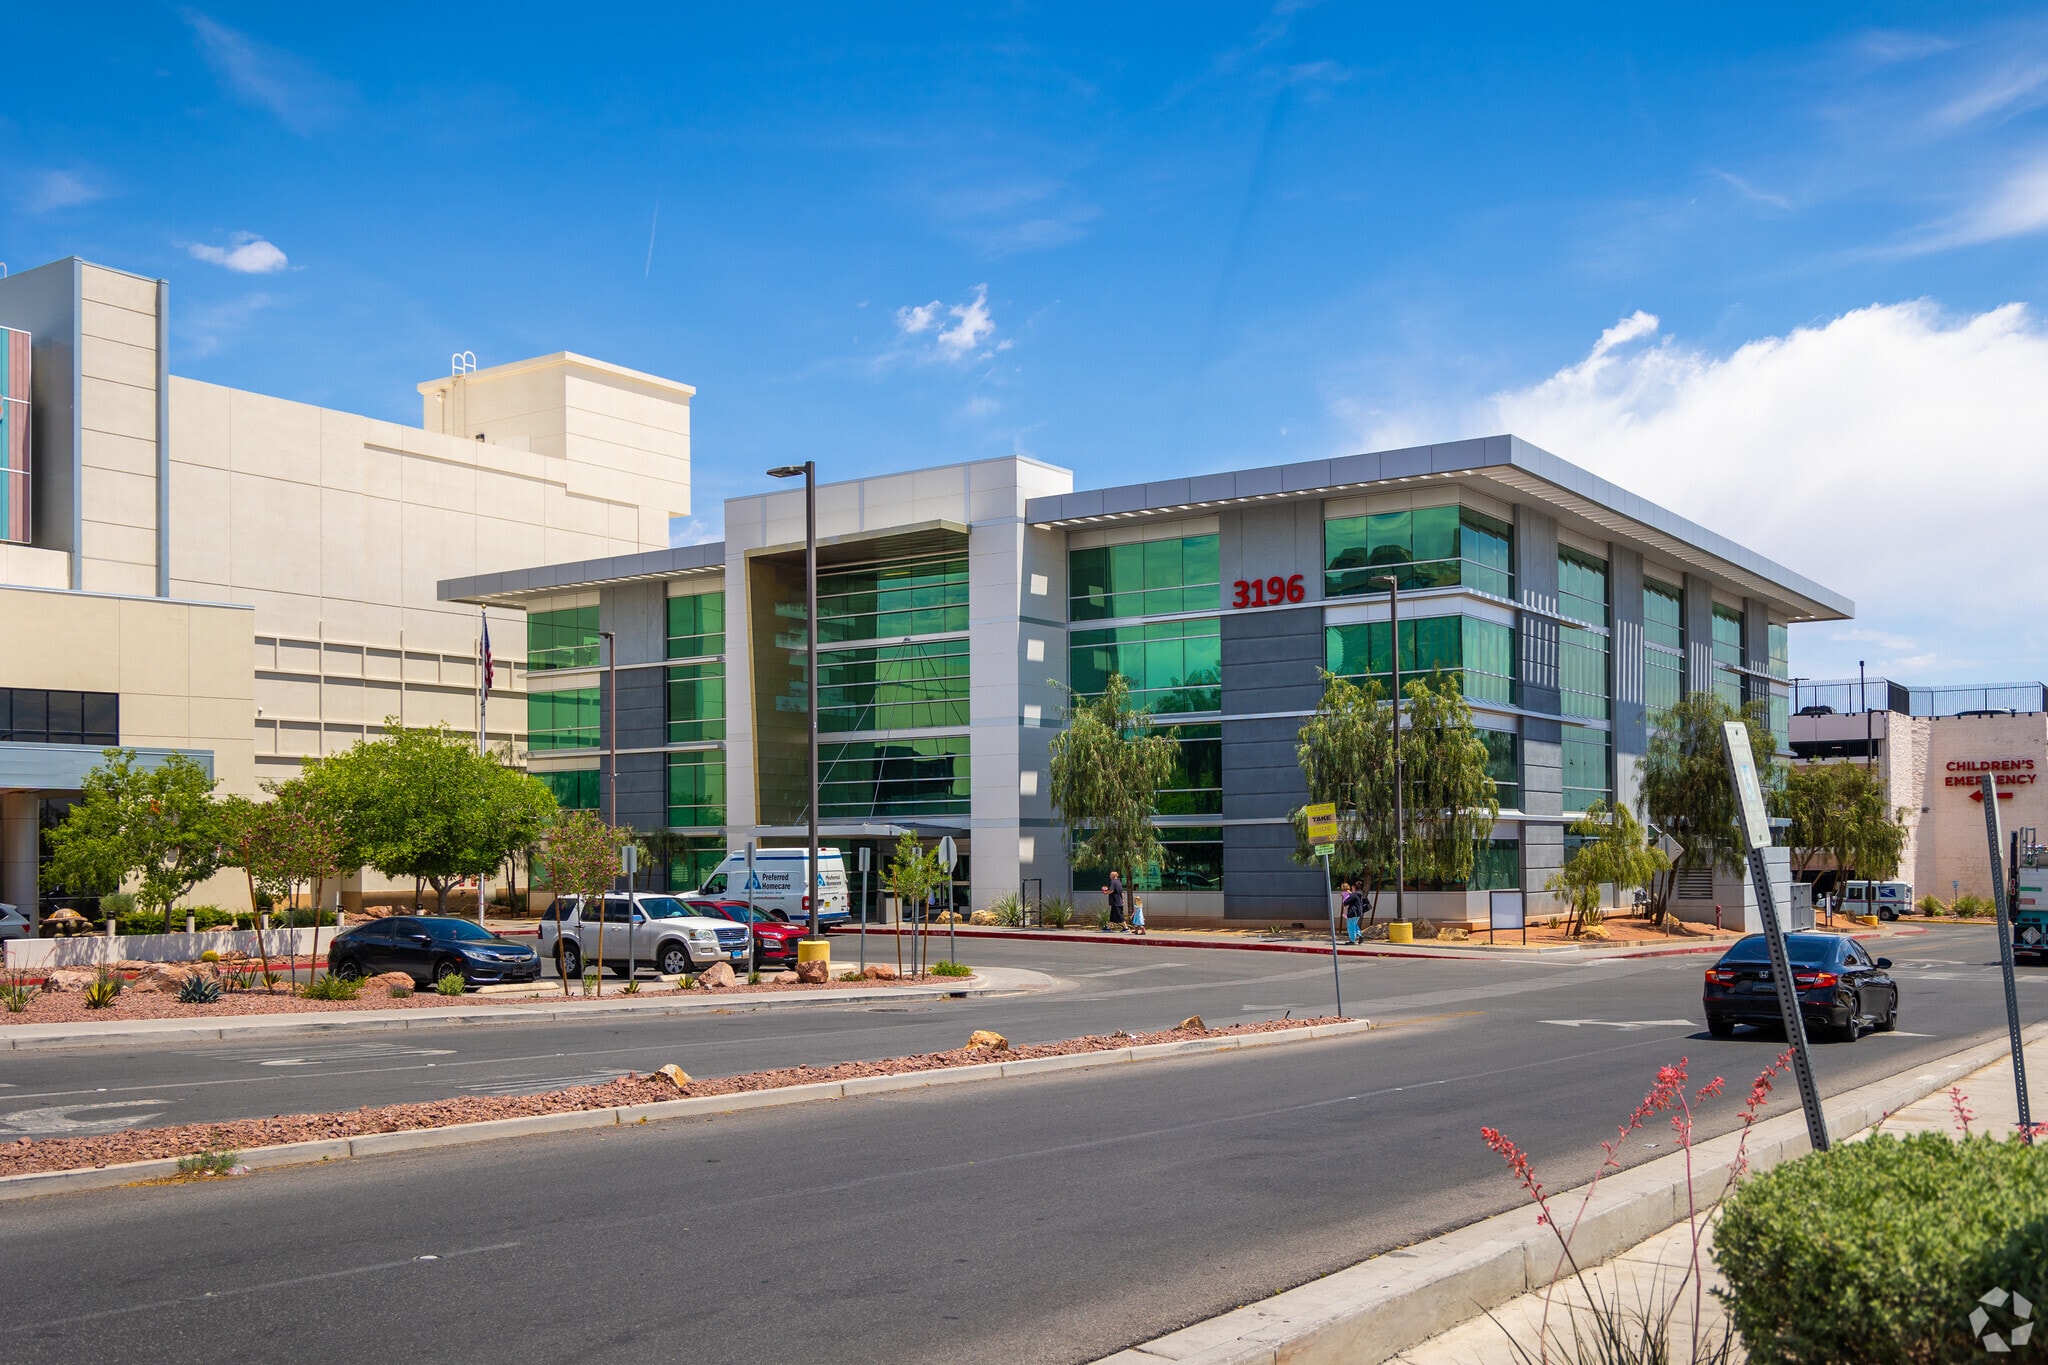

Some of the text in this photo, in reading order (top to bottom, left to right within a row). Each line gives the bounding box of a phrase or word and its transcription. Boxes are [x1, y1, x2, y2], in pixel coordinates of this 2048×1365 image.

[1232, 574, 1305, 608] 3196
[1945, 760, 2034, 771] CHILDREN'S
[1945, 774, 2037, 787] EMERENCY
[762, 873, 789, 881] Preferred
[761, 882, 791, 890] Homecare
